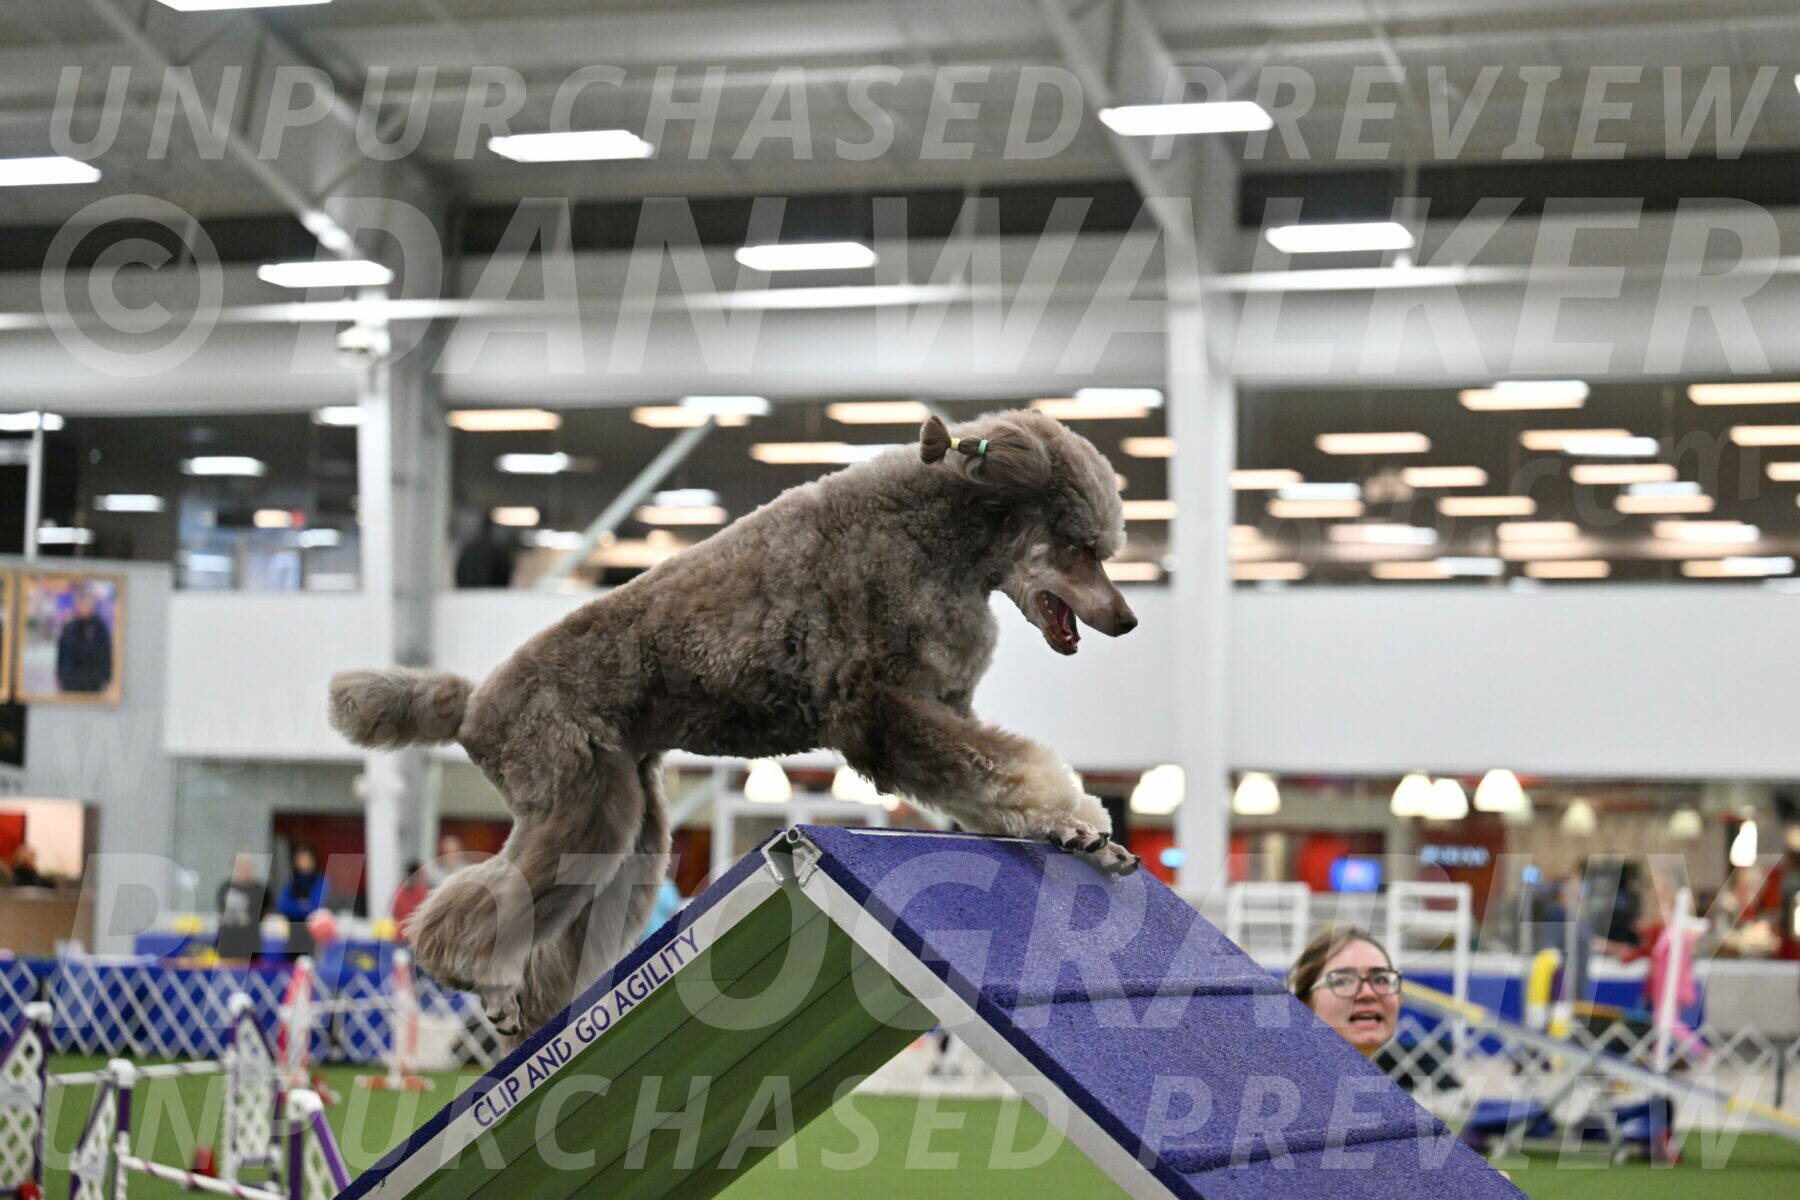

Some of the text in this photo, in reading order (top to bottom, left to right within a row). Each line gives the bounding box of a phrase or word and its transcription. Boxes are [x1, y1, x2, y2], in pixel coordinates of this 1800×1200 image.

[473, 927, 700, 1127] CLIP AND GO AGILITY
